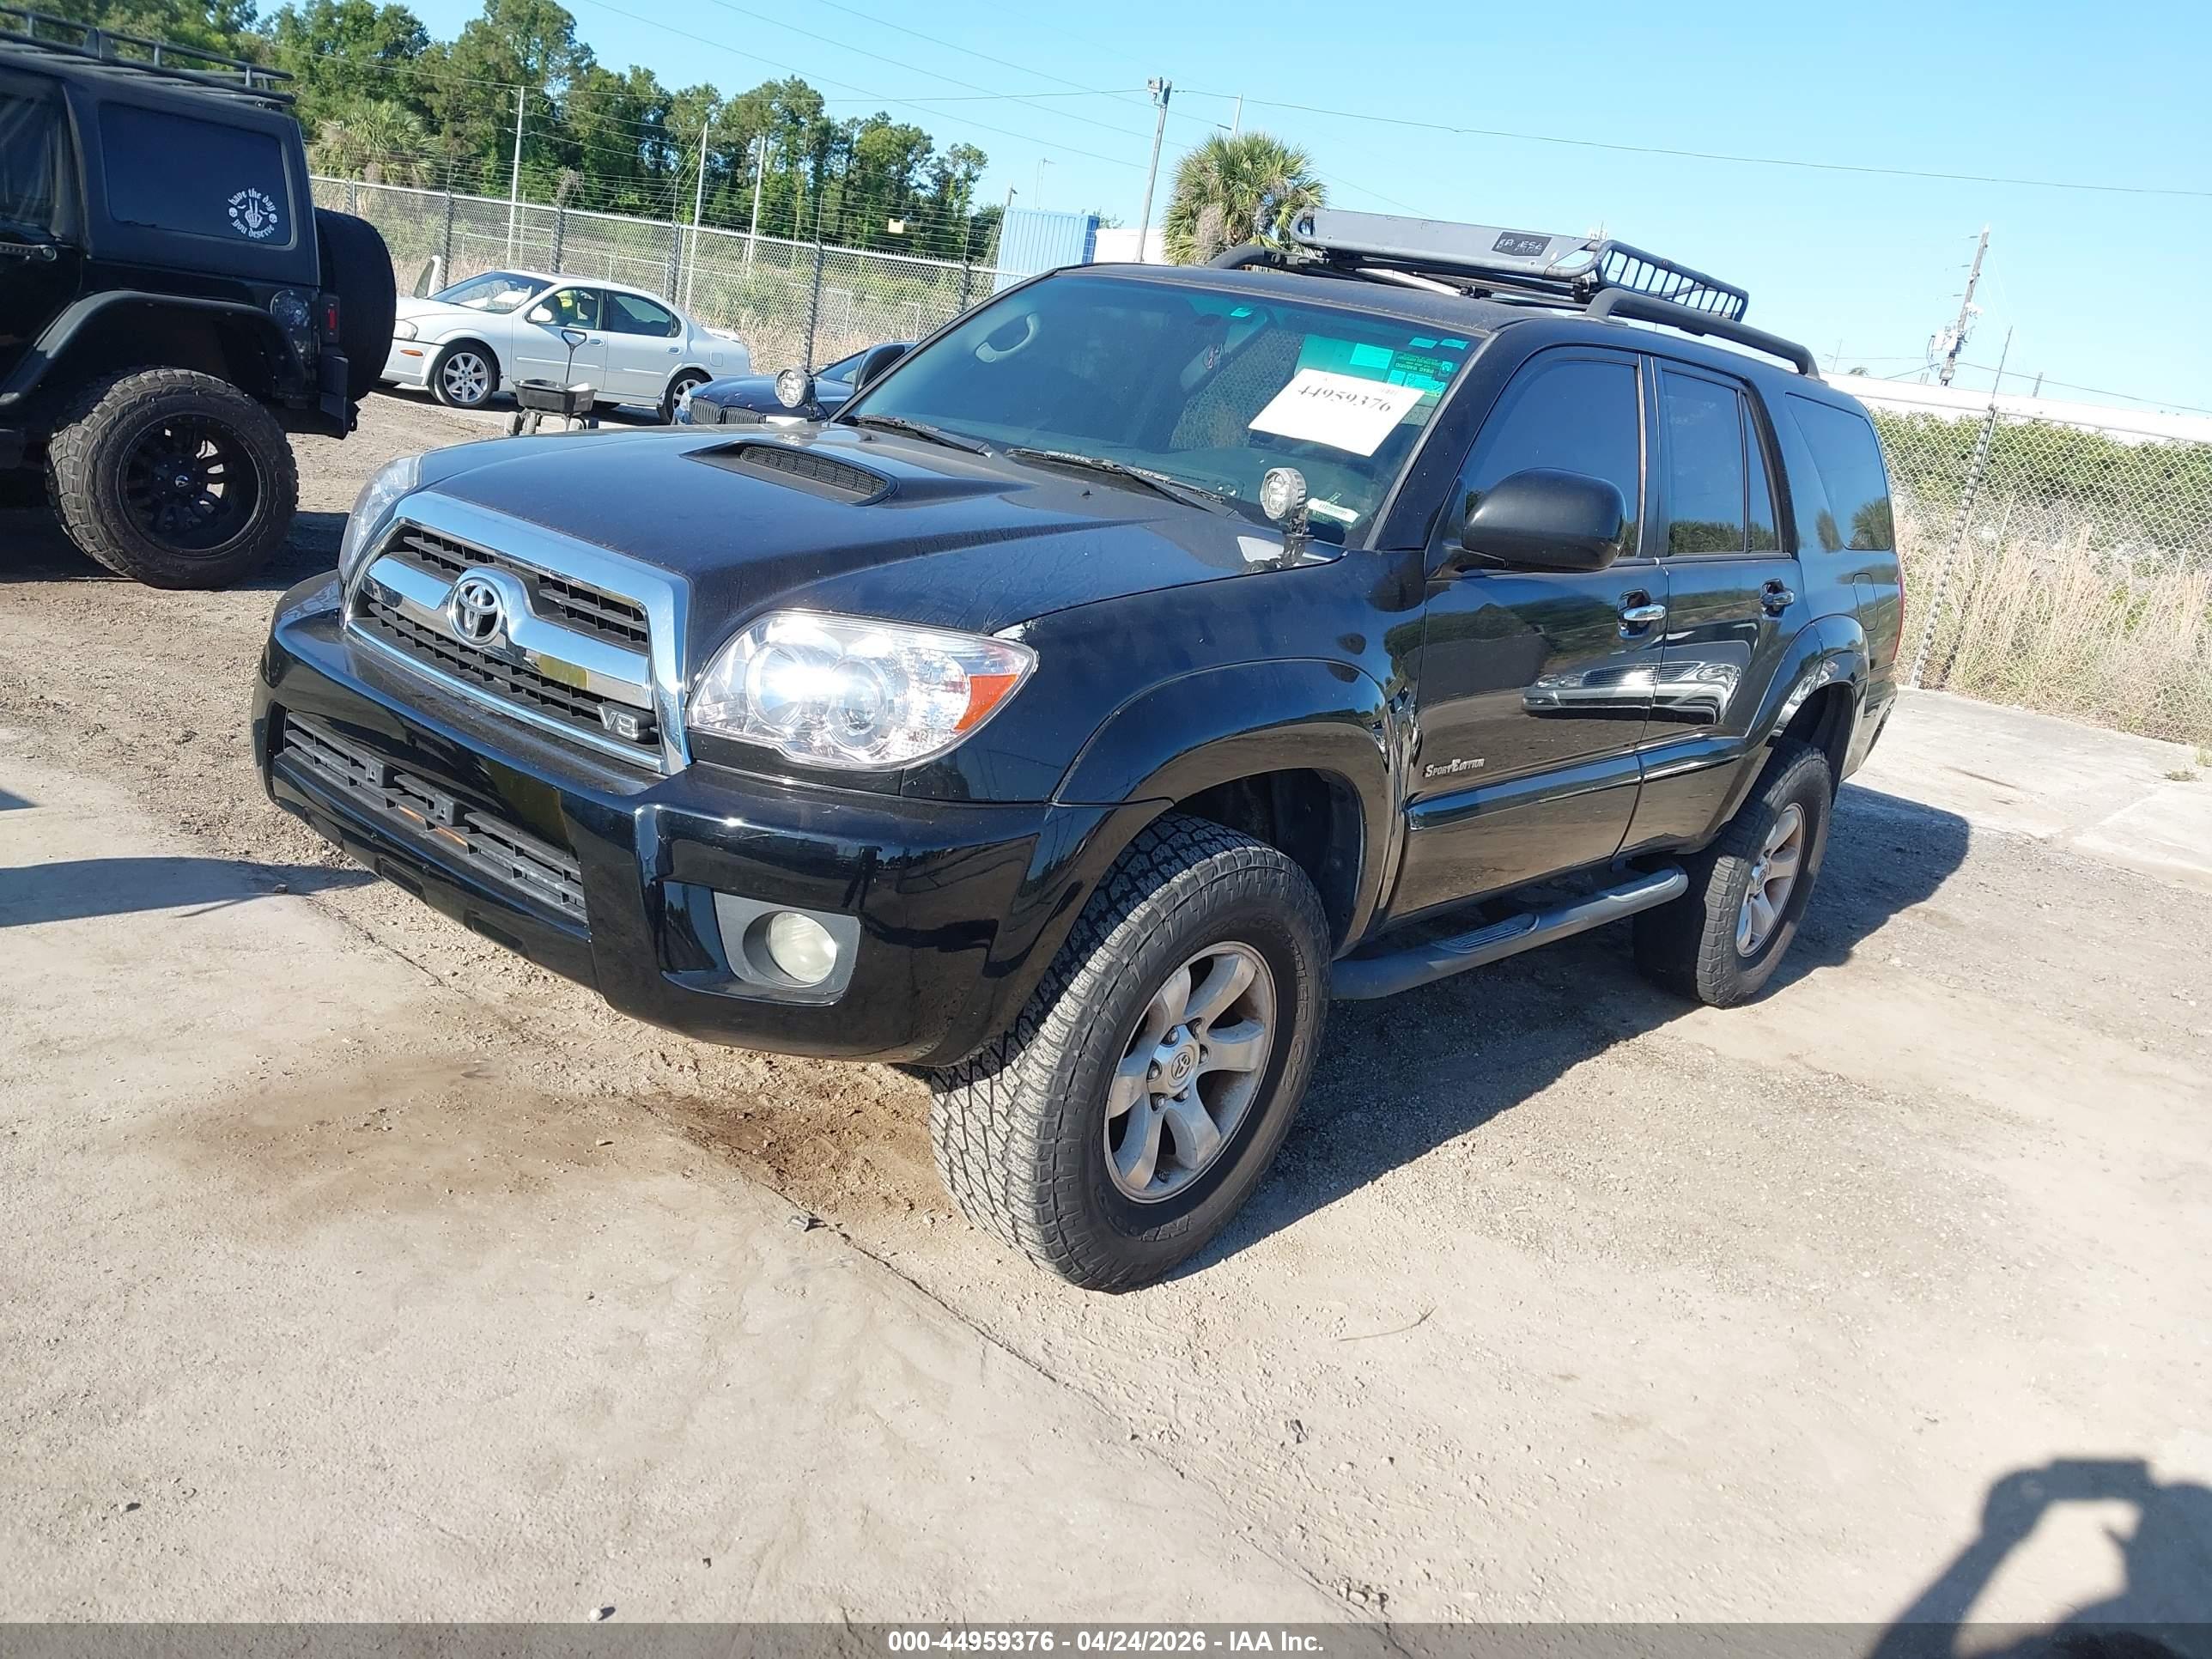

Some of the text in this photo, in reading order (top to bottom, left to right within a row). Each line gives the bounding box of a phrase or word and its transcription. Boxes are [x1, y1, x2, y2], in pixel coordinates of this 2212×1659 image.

[228, 187, 276, 212] have the day
[231, 219, 275, 239] you deserve
[596, 703, 639, 741] V8
